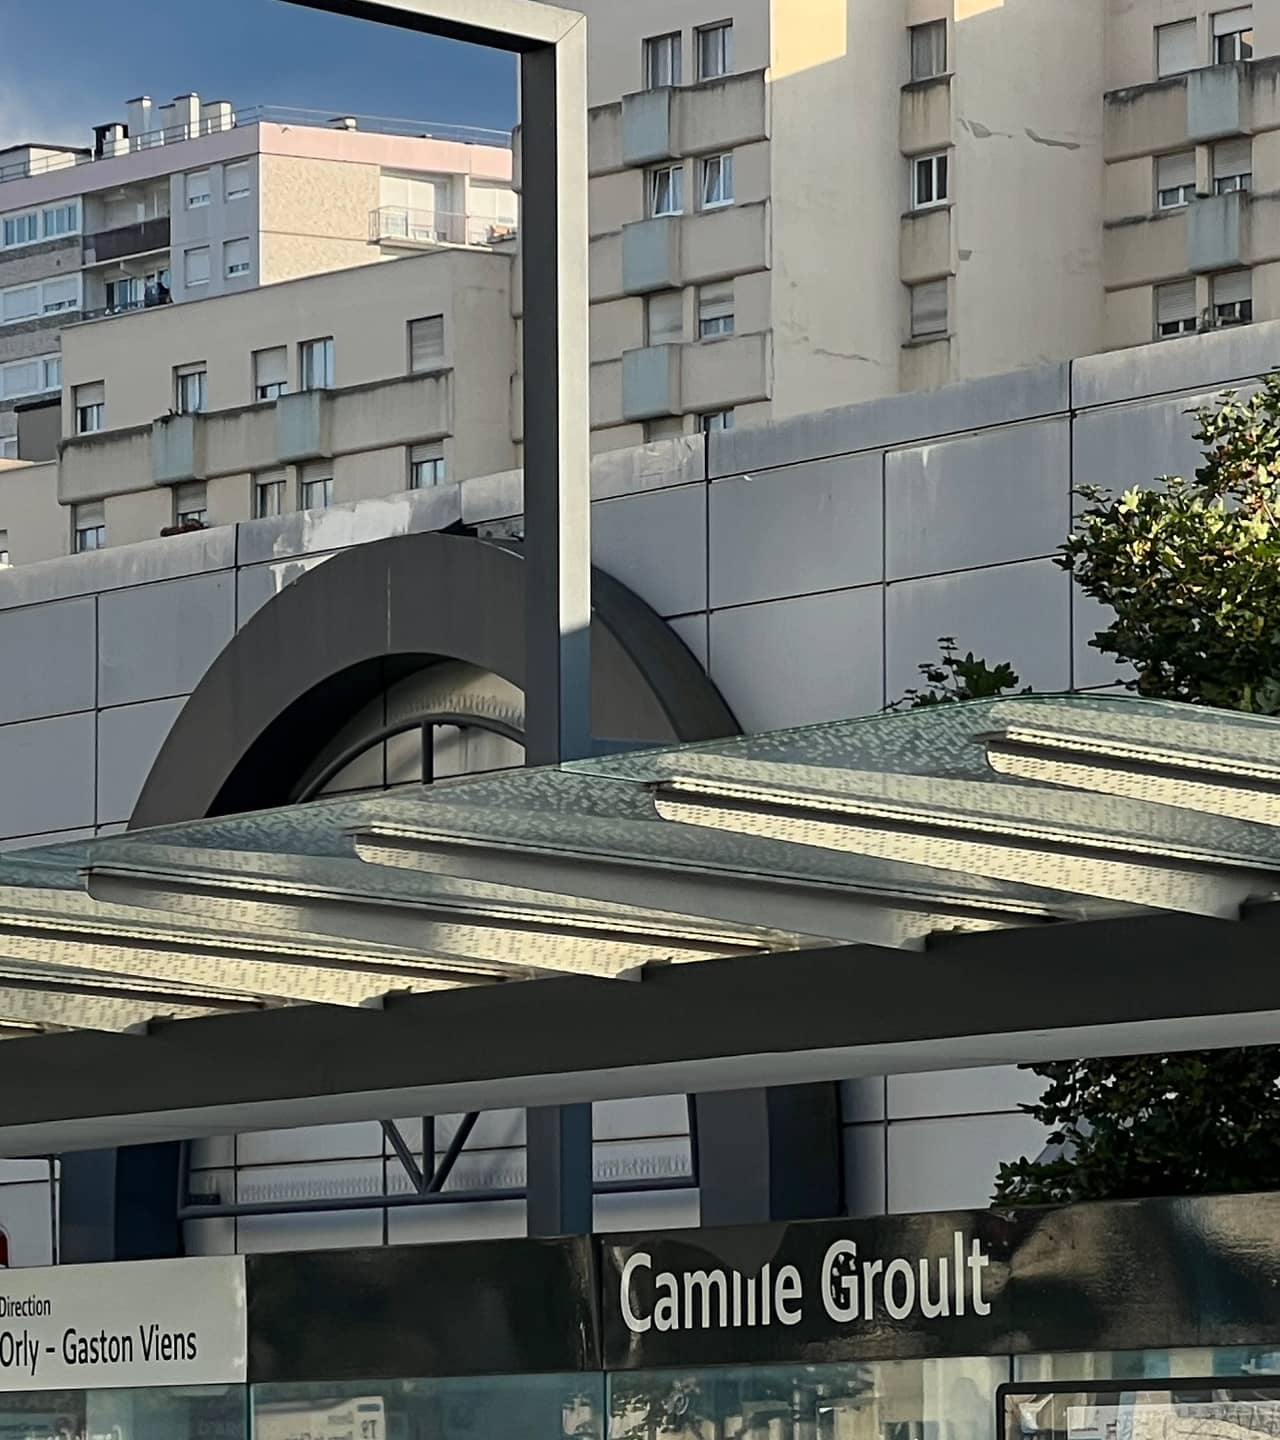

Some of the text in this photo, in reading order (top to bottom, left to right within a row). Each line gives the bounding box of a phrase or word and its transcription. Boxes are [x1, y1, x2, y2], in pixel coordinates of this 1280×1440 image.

[821, 1230, 992, 1324] Groult
[0, 1329, 41, 1377] Orly
[62, 1327, 134, 1366] Gaston
[139, 1323, 198, 1363] Viens
